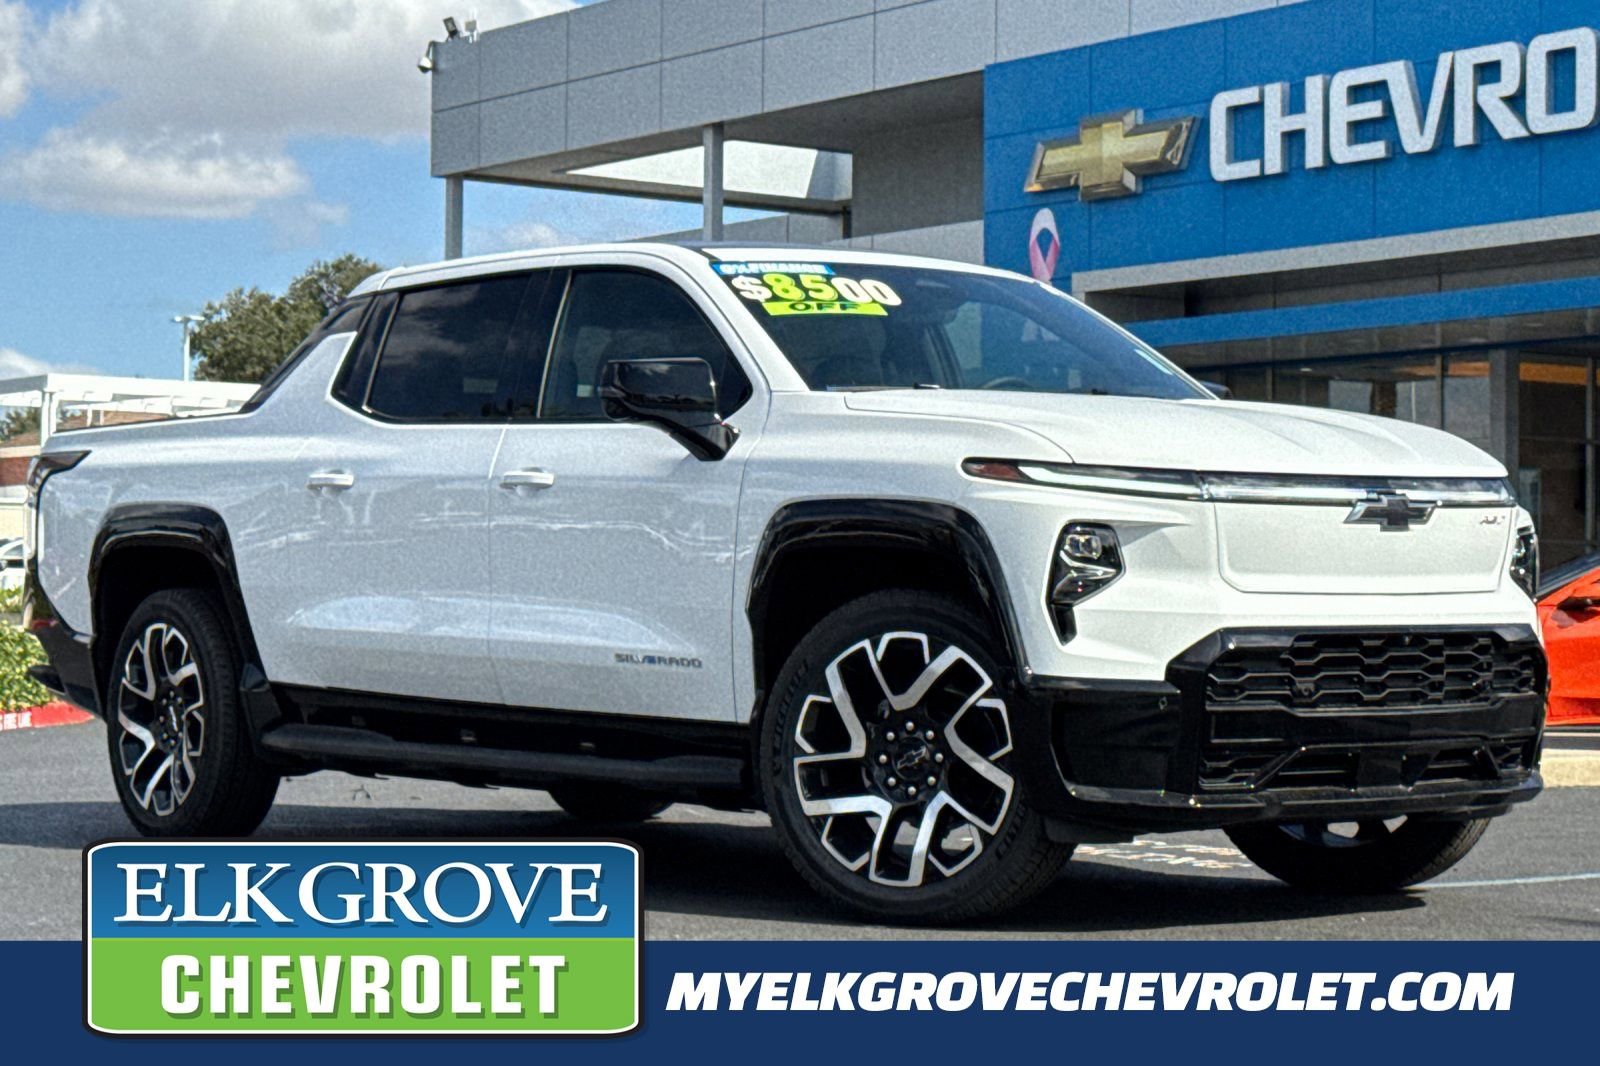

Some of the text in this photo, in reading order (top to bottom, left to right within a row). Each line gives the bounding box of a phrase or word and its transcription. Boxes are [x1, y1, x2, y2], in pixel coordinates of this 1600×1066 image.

[1209, 26, 1599, 182] CHEVRO
[731, 273, 902, 306] $8500
[788, 301, 862, 312] OFF
[614, 653, 703, 668] SILVERADO
